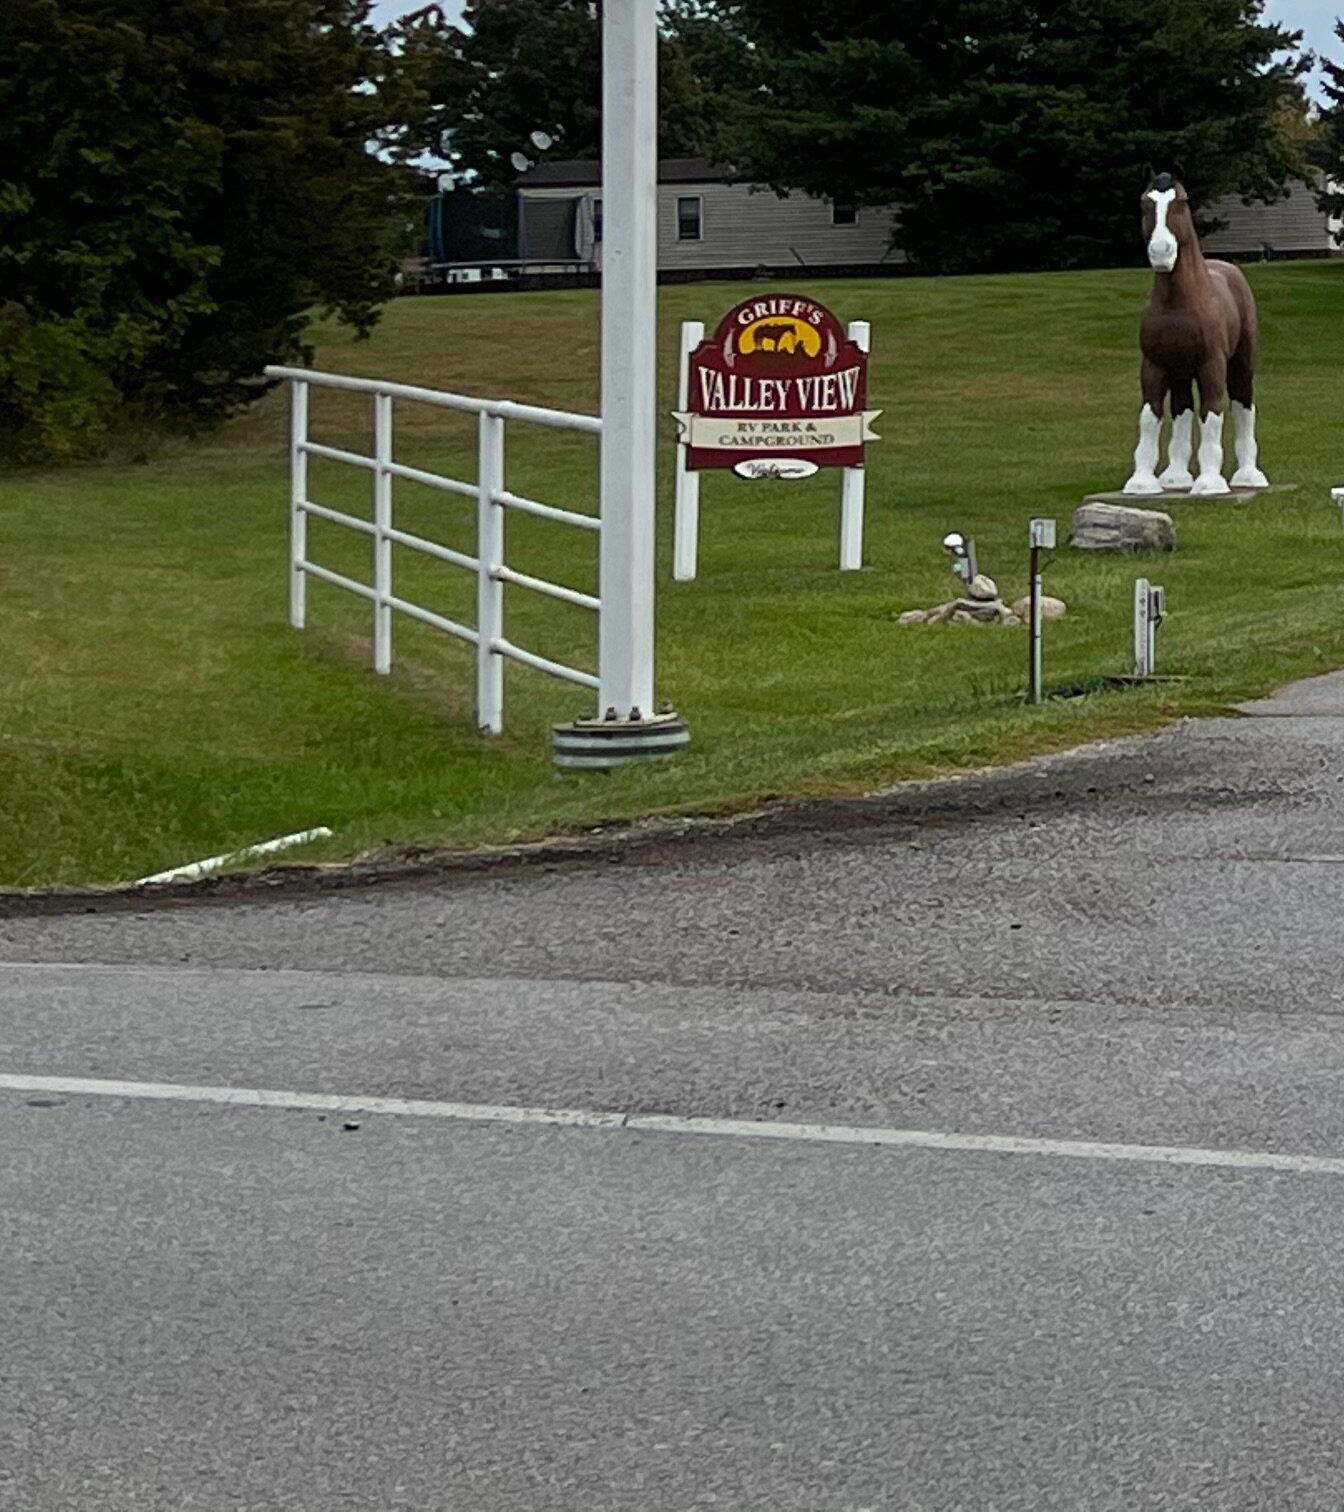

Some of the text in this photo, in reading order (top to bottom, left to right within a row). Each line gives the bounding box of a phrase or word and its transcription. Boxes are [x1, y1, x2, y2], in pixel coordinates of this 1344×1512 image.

[737, 299, 824, 325] GRIFF'S
[698, 366, 860, 411] VALLEY VIEW
[737, 422, 817, 433] RV PARK &
[718, 434, 836, 447] CAMPGROUND
